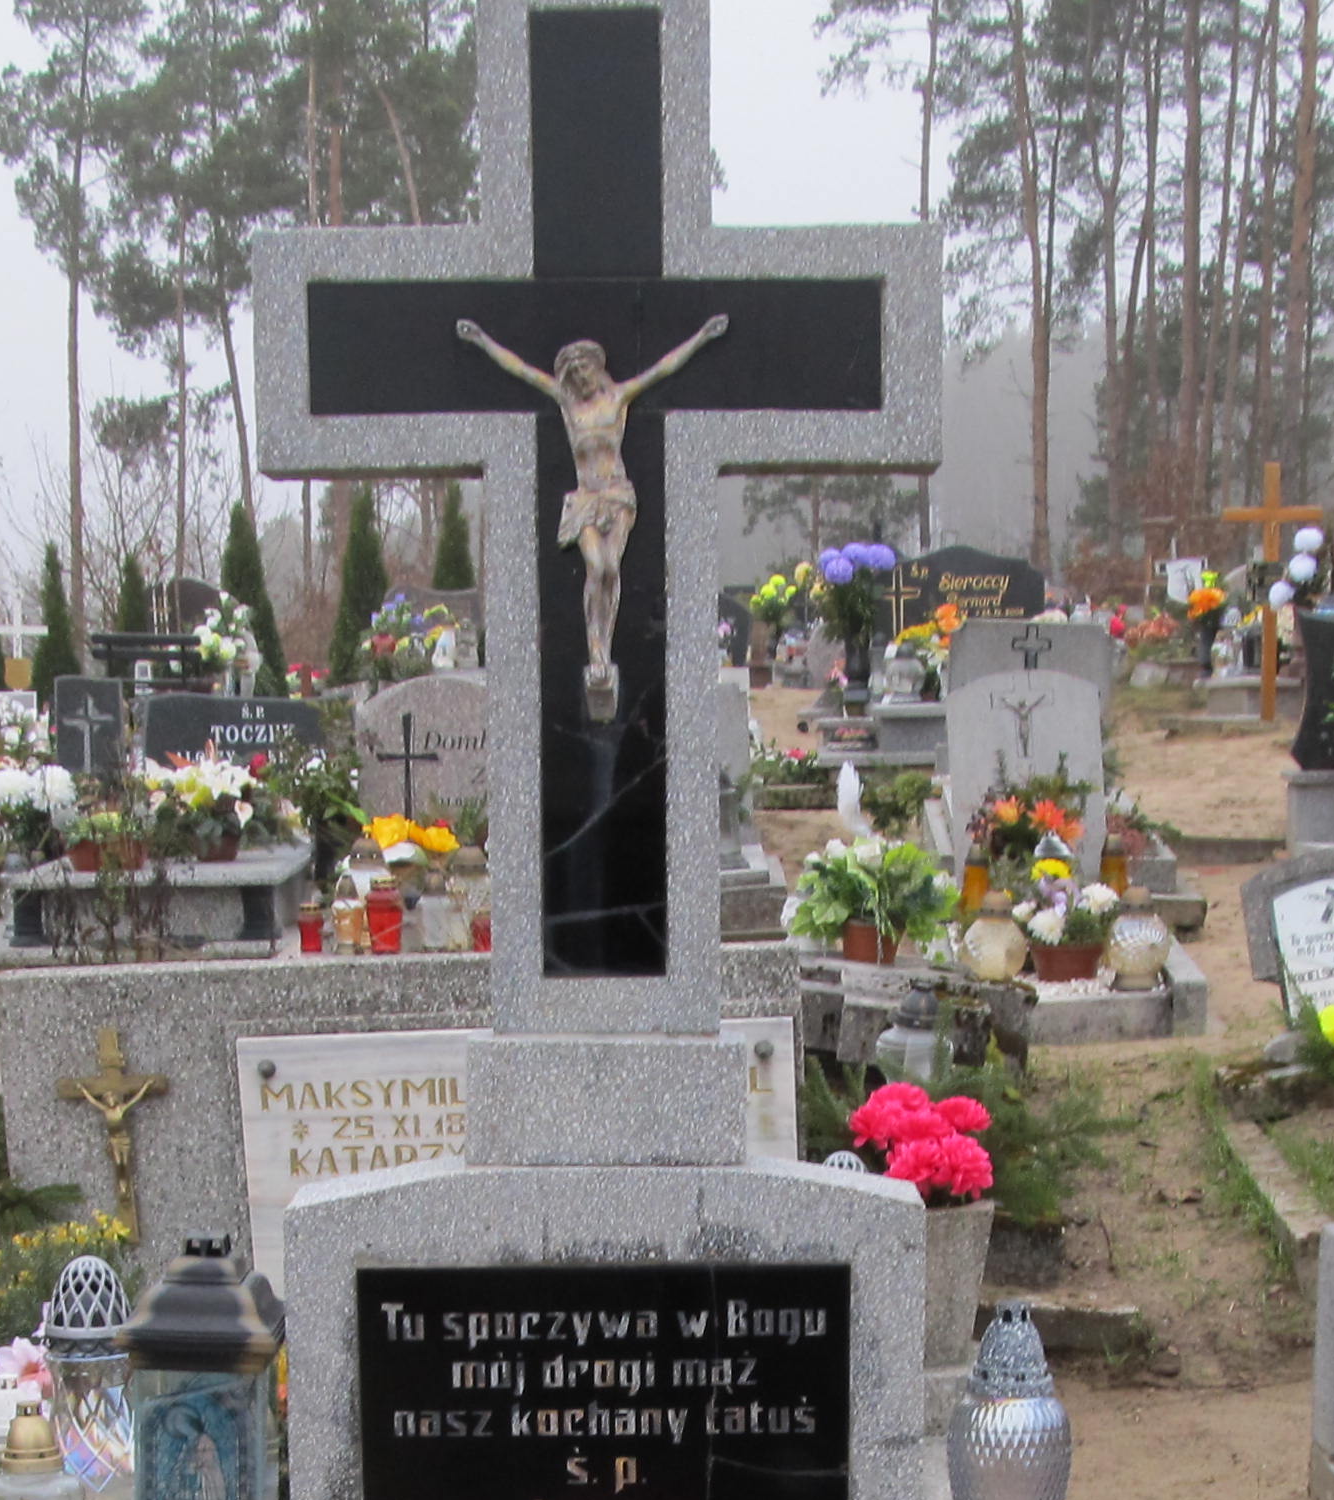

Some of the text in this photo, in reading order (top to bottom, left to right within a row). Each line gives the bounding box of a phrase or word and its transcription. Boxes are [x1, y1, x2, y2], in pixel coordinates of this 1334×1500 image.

[259, 1076, 467, 1113] MAKSYMIL
[380, 1297, 828, 1351] Tu spoczywa w Bogu
[451, 1349, 759, 1396] mój drogi mąż
[393, 1395, 817, 1445] nasz kochany tatuś
